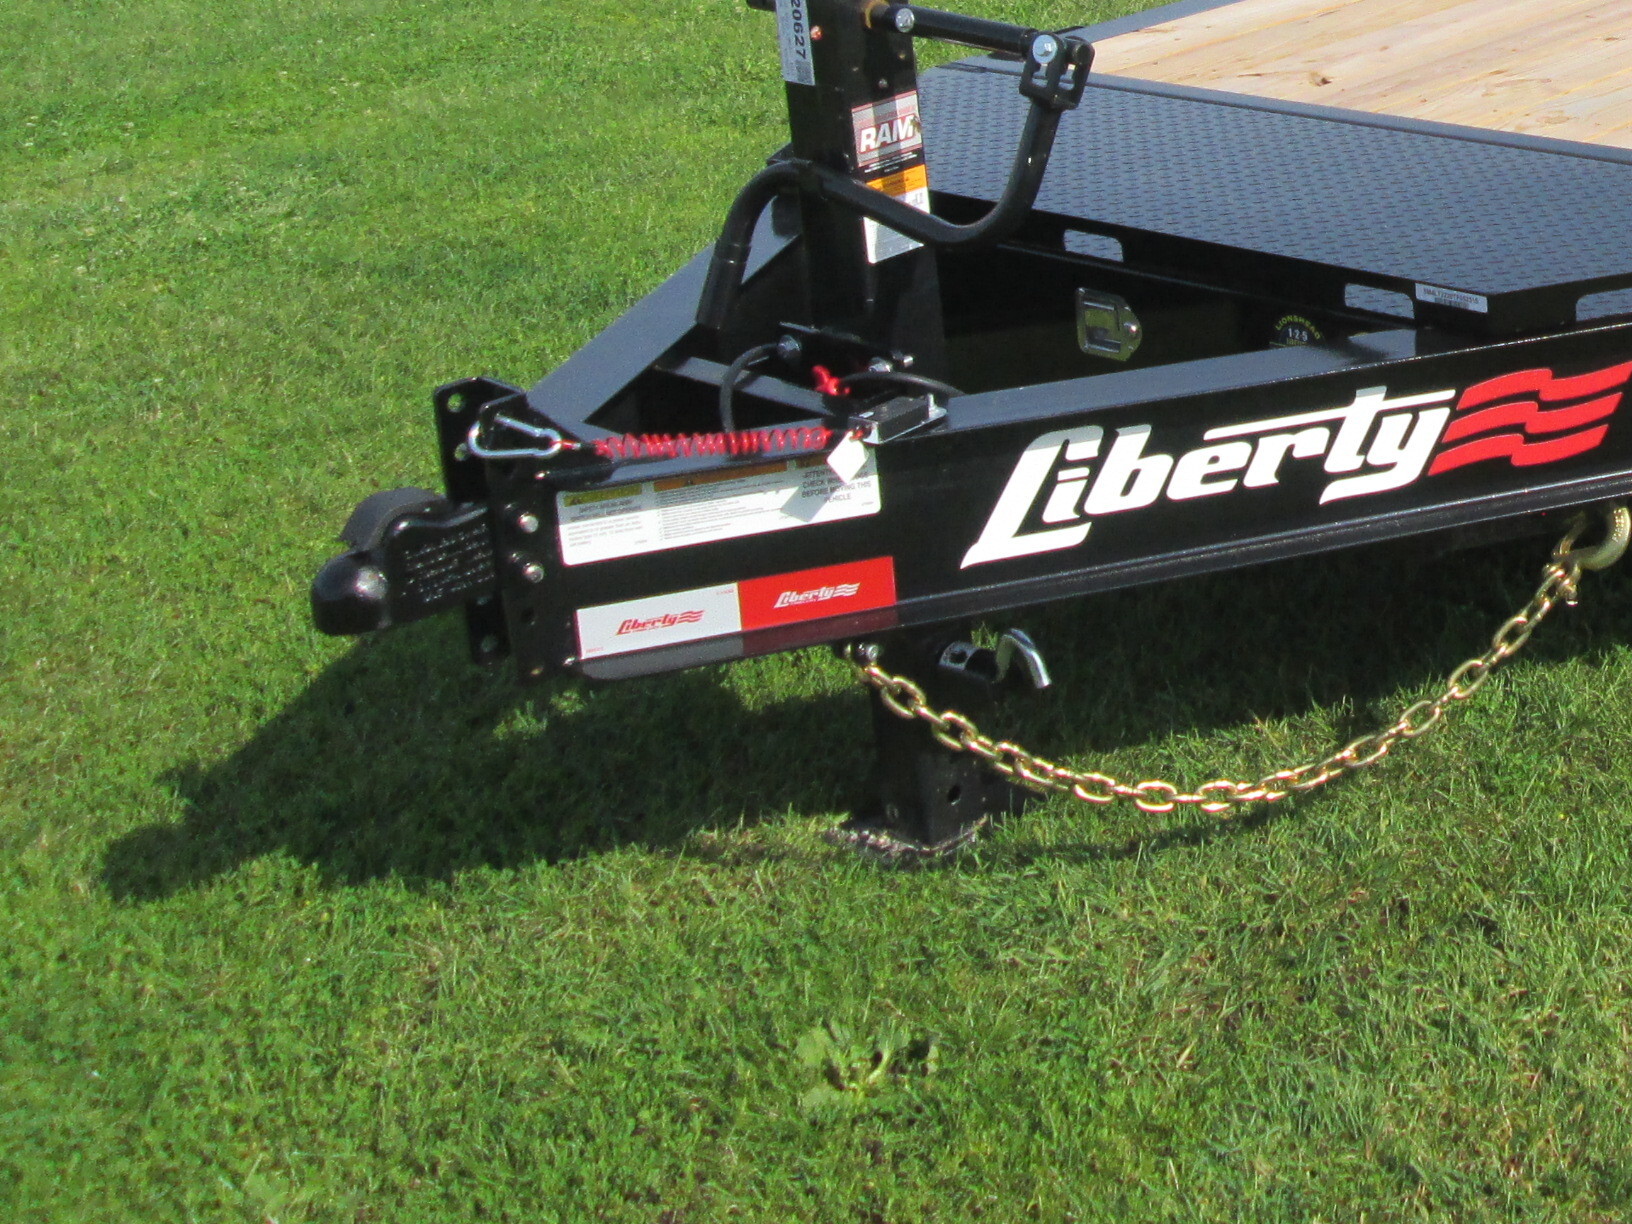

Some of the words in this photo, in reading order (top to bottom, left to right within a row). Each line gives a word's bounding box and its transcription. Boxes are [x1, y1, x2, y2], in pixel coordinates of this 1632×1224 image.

[860, 115, 916, 153] RAM
[961, 384, 1456, 569] Liberty
[802, 488, 827, 498] BEFORE
[858, 480, 872, 488] THIS
[773, 585, 834, 609] Liberty
[616, 613, 678, 636] Liberty
